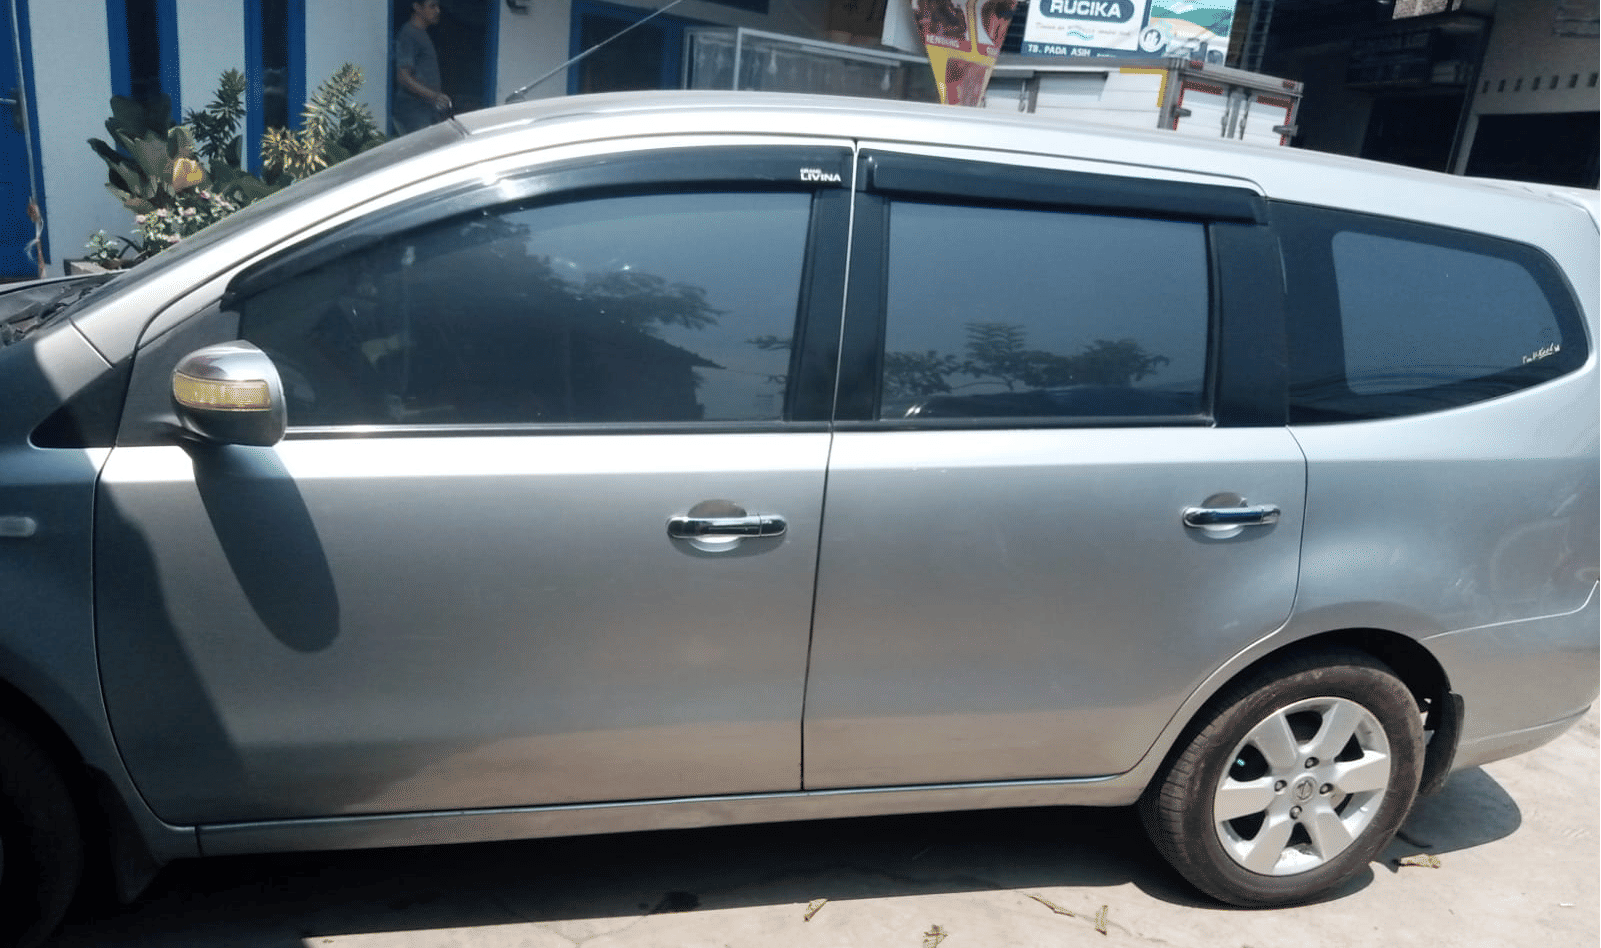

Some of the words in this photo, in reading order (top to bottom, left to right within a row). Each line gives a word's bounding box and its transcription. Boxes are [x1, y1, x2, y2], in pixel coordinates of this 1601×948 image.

[1049, 0, 1121, 18] RUCIKA
[1044, 45, 1067, 55] PADA
[800, 173, 841, 181] LIVINA
